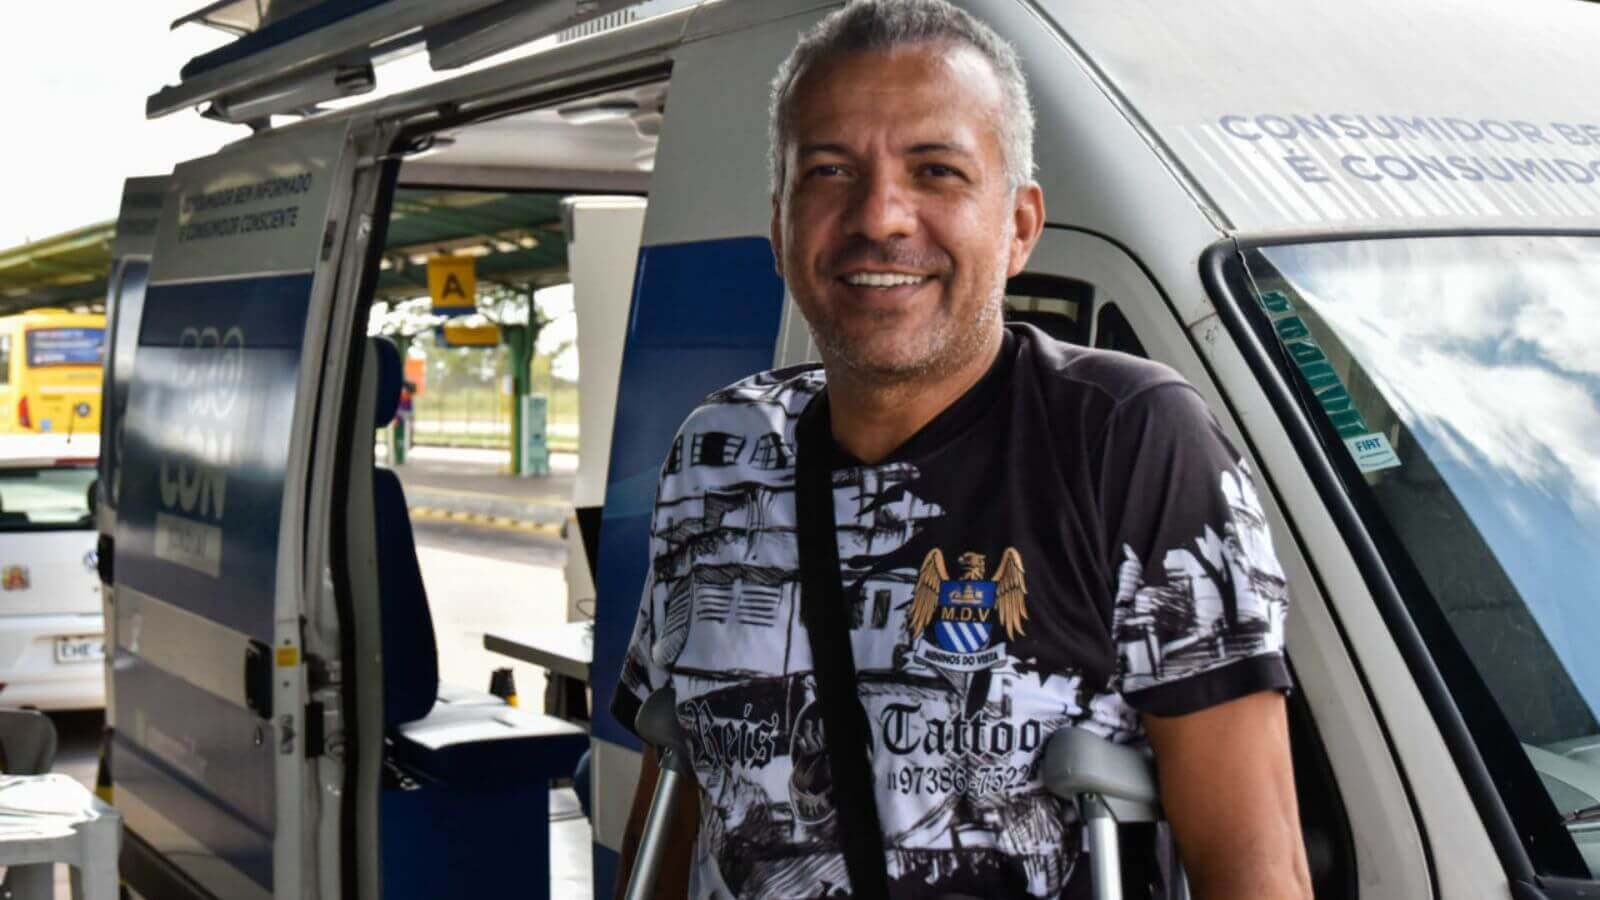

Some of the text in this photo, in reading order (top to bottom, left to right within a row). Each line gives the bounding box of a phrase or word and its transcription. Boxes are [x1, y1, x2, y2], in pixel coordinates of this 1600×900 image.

[1218, 113, 1554, 145] CONSUMIDOR
[1284, 147, 1330, 183] É
[442, 272, 466, 299] A
[1355, 437, 1382, 452] FIAT
[962, 655, 975, 666] DO
[880, 702, 1041, 756] Tattoo
